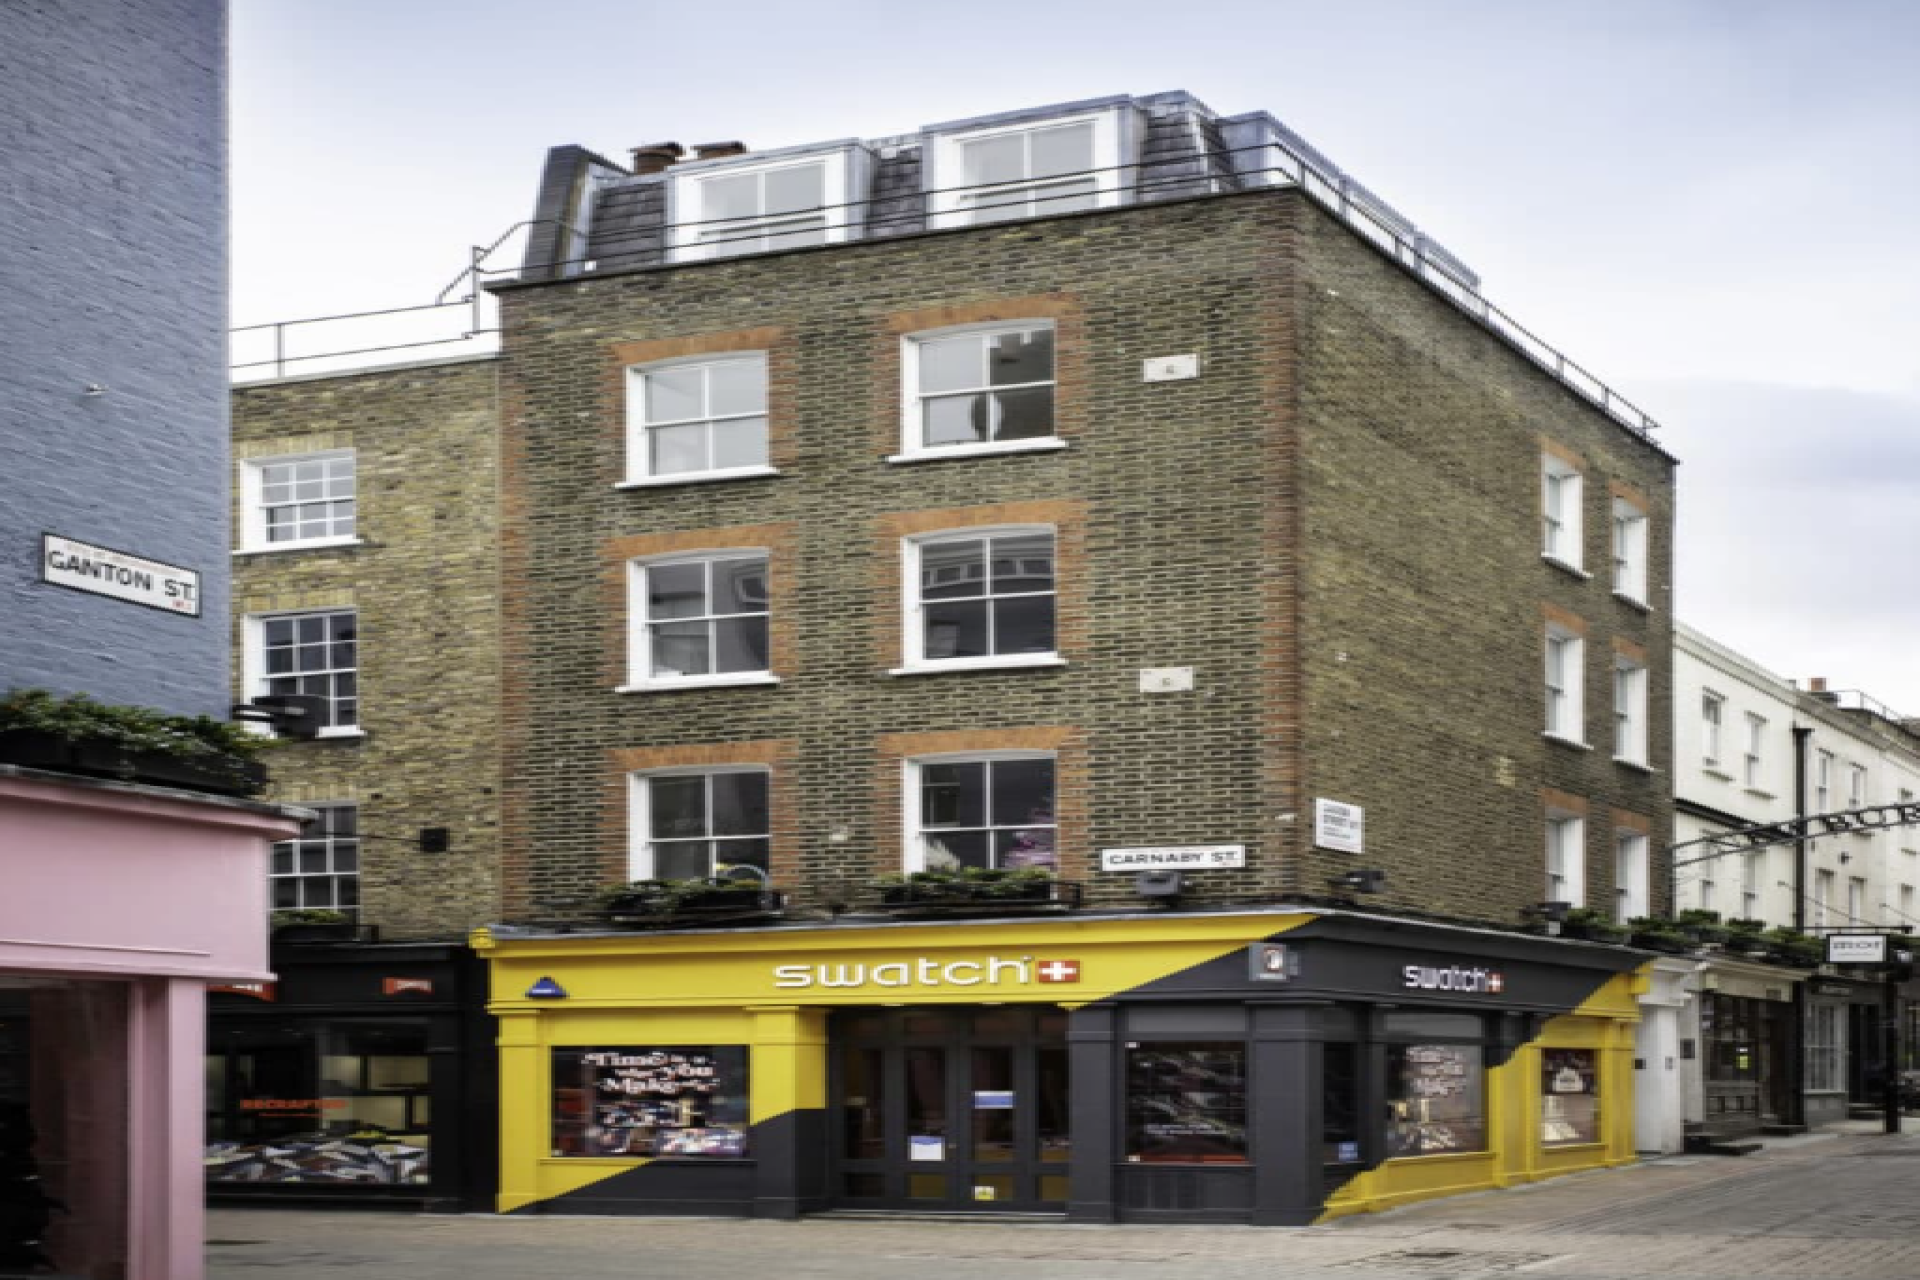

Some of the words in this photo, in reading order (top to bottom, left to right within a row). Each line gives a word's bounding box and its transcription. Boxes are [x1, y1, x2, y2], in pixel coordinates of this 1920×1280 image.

[50, 551, 153, 591] GANTON
[1109, 852, 1204, 865] CARNABY
[1211, 850, 1239, 863] ST
[773, 956, 1030, 987] swatch
[1403, 964, 1487, 992] swatch
